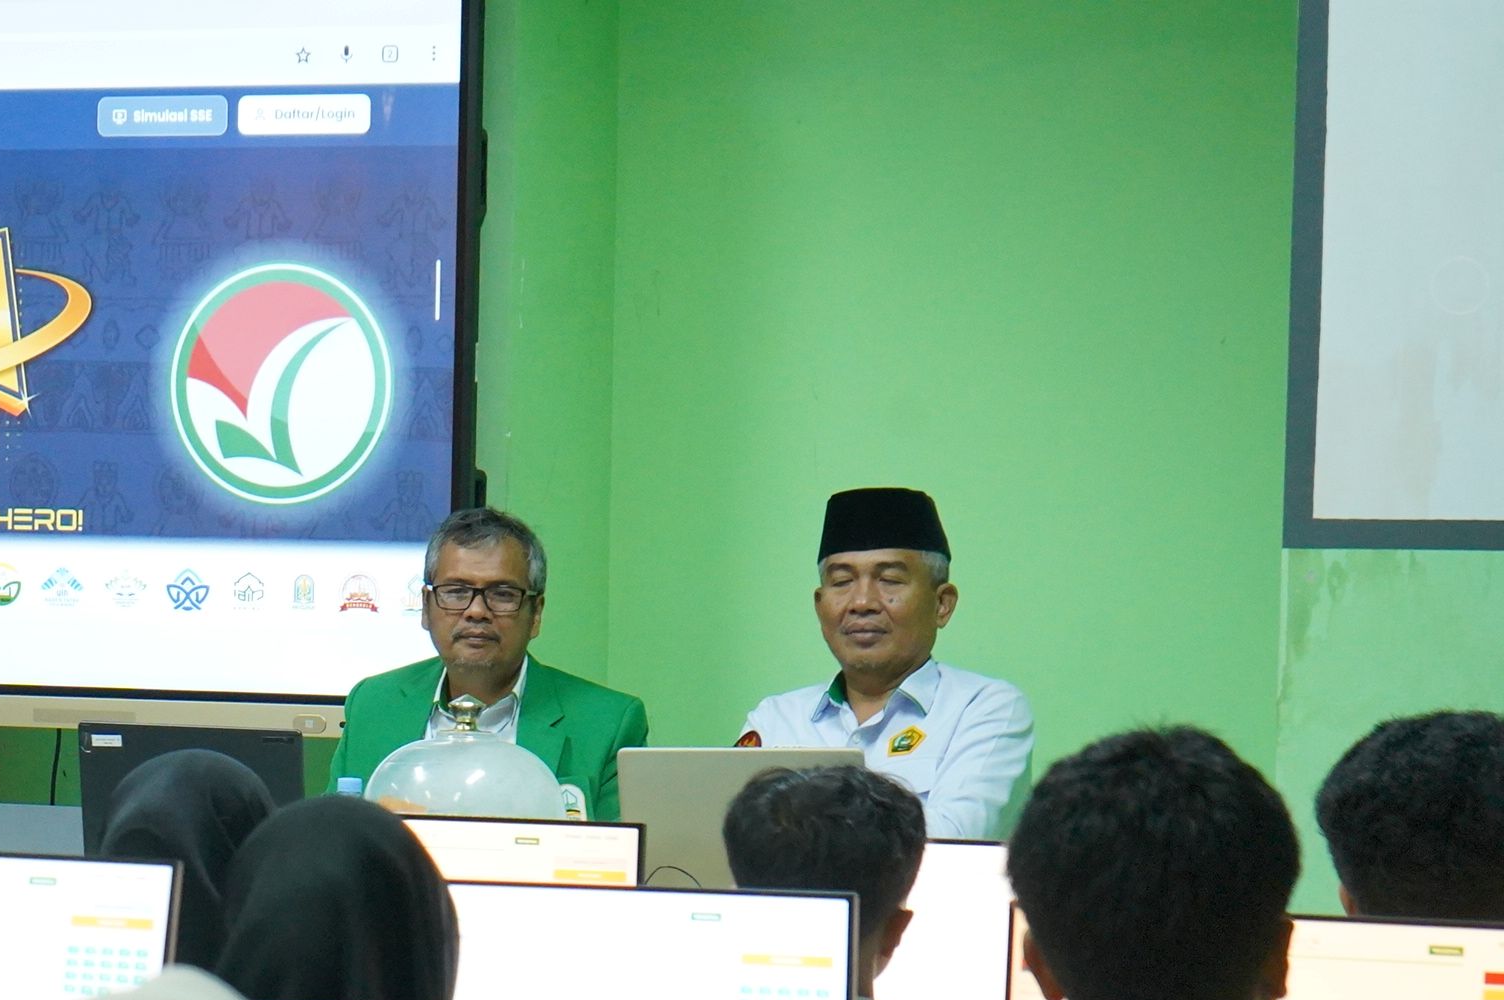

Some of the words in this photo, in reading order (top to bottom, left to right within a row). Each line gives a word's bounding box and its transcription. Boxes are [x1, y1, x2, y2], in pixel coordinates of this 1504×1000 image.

[133, 108, 188, 123] Simulasi
[190, 108, 213, 122] SSE
[274, 107, 356, 121] Daftar/Login
